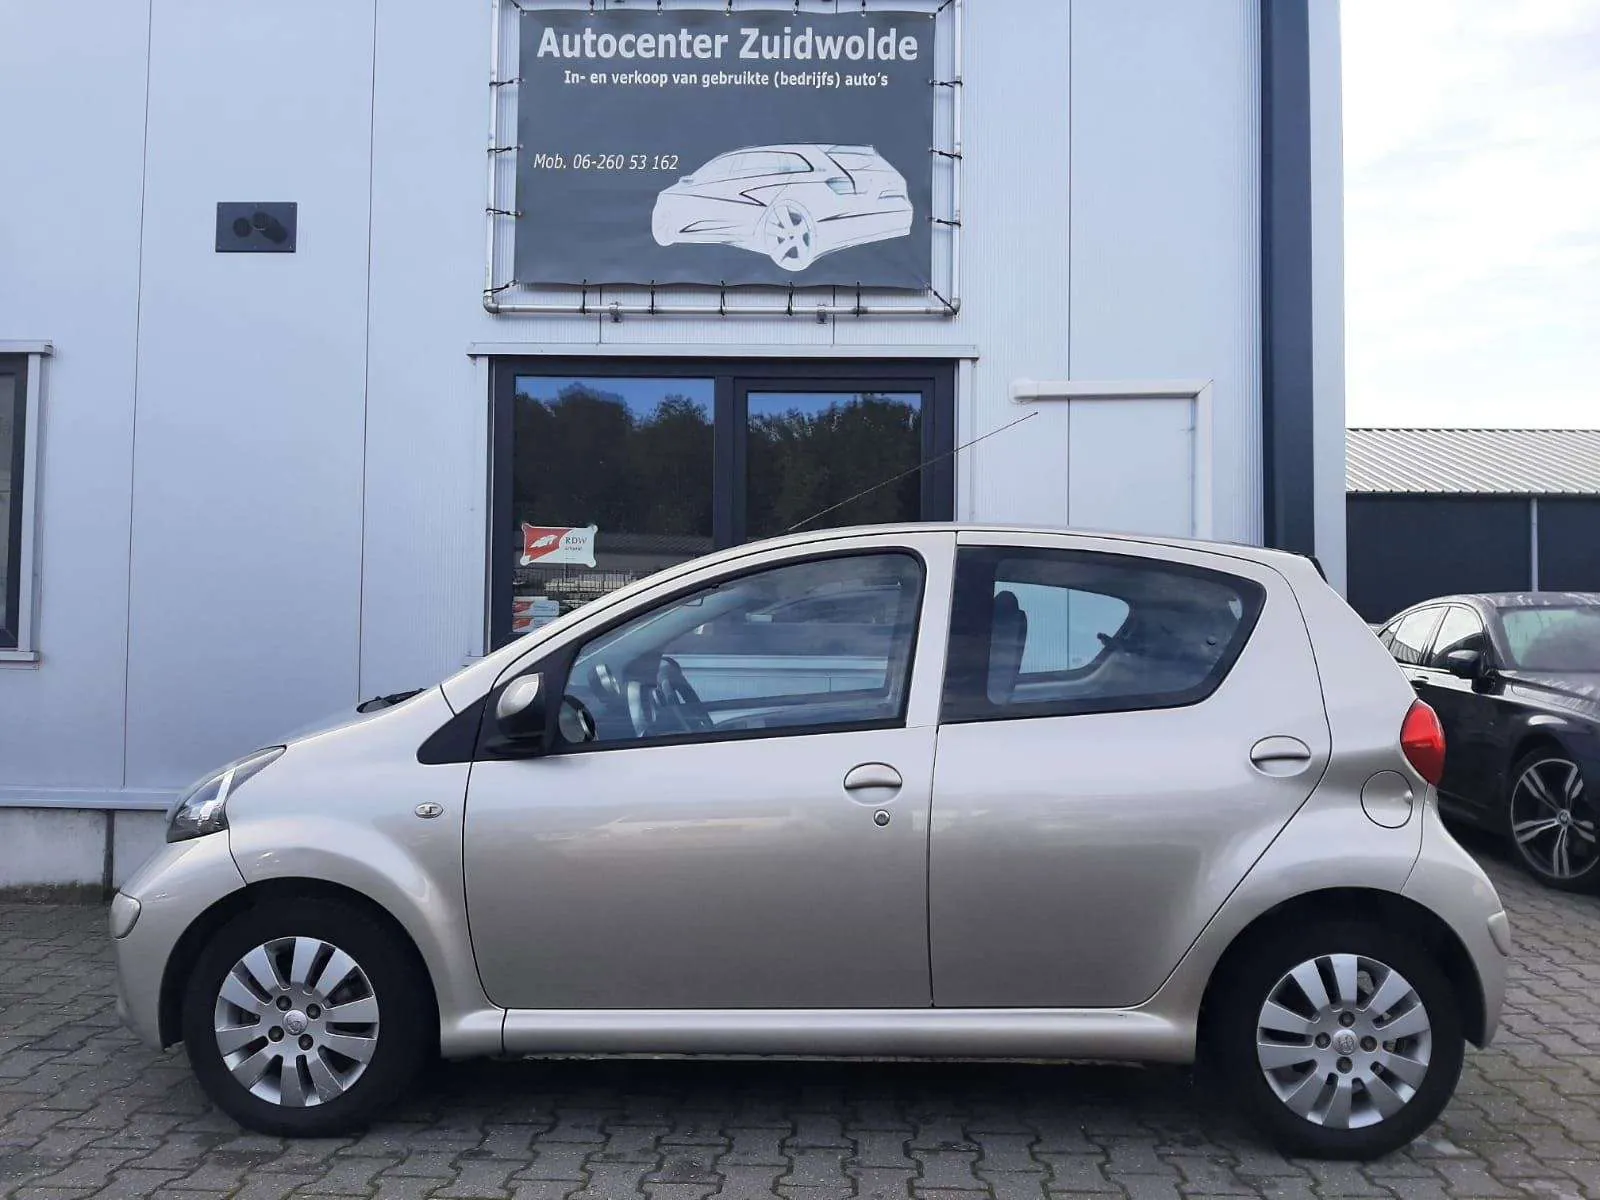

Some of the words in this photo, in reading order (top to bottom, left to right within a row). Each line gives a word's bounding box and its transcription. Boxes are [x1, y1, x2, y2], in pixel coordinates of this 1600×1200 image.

[537, 27, 728, 59] Autocenter
[739, 27, 918, 61] Zuidwolde
[564, 70, 586, 84] In-
[590, 73, 607, 84] en
[611, 70, 668, 87] verkoop
[672, 73, 698, 85] van
[702, 71, 769, 88] gebruikte
[774, 71, 841, 88] (bedrijfs)
[533, 153, 567, 169] Mob.
[573, 154, 624, 170] 06-260
[629, 155, 648, 170] 53
[652, 155, 679, 171] 162
[565, 536, 588, 544] RDW
